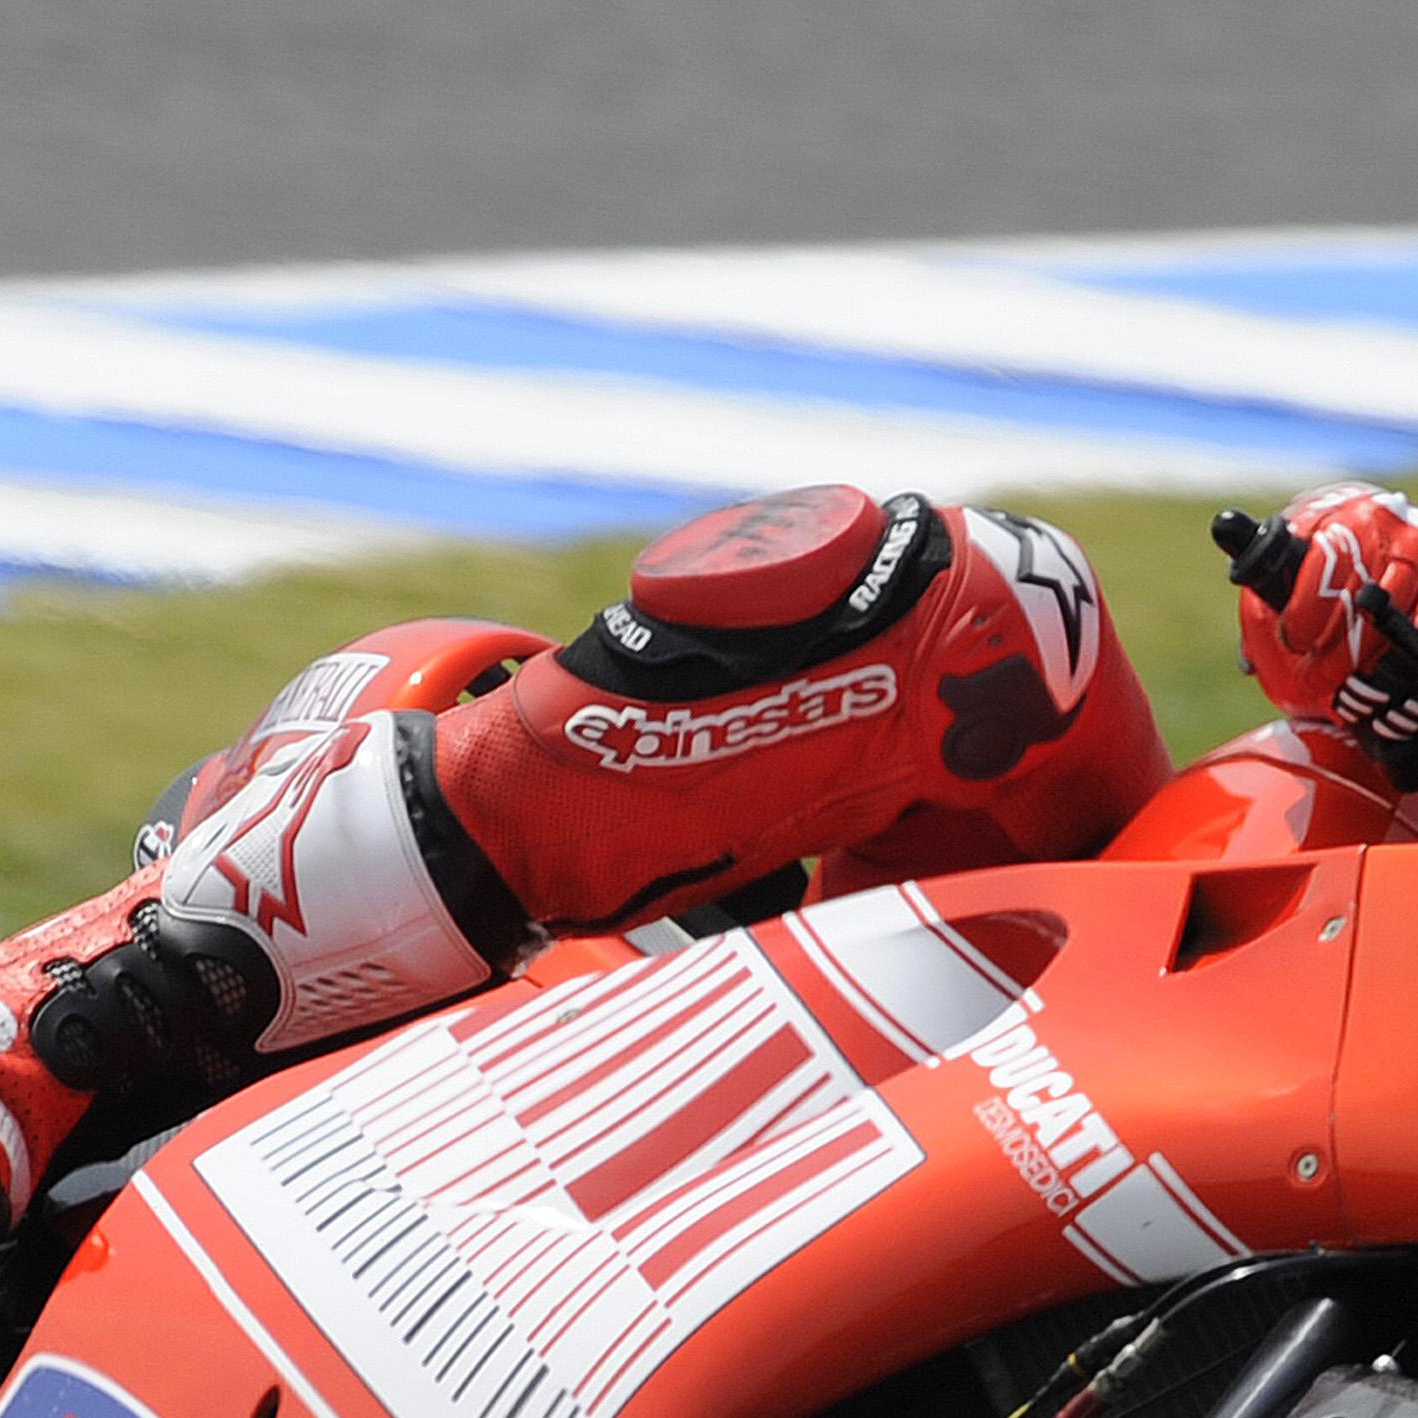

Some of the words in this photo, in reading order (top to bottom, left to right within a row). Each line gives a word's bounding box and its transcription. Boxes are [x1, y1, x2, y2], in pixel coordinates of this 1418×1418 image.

[849, 520, 918, 612] RACING
[970, 1023, 1135, 1199] DUCATI
[973, 1096, 1080, 1218] DESMOSEDICI
